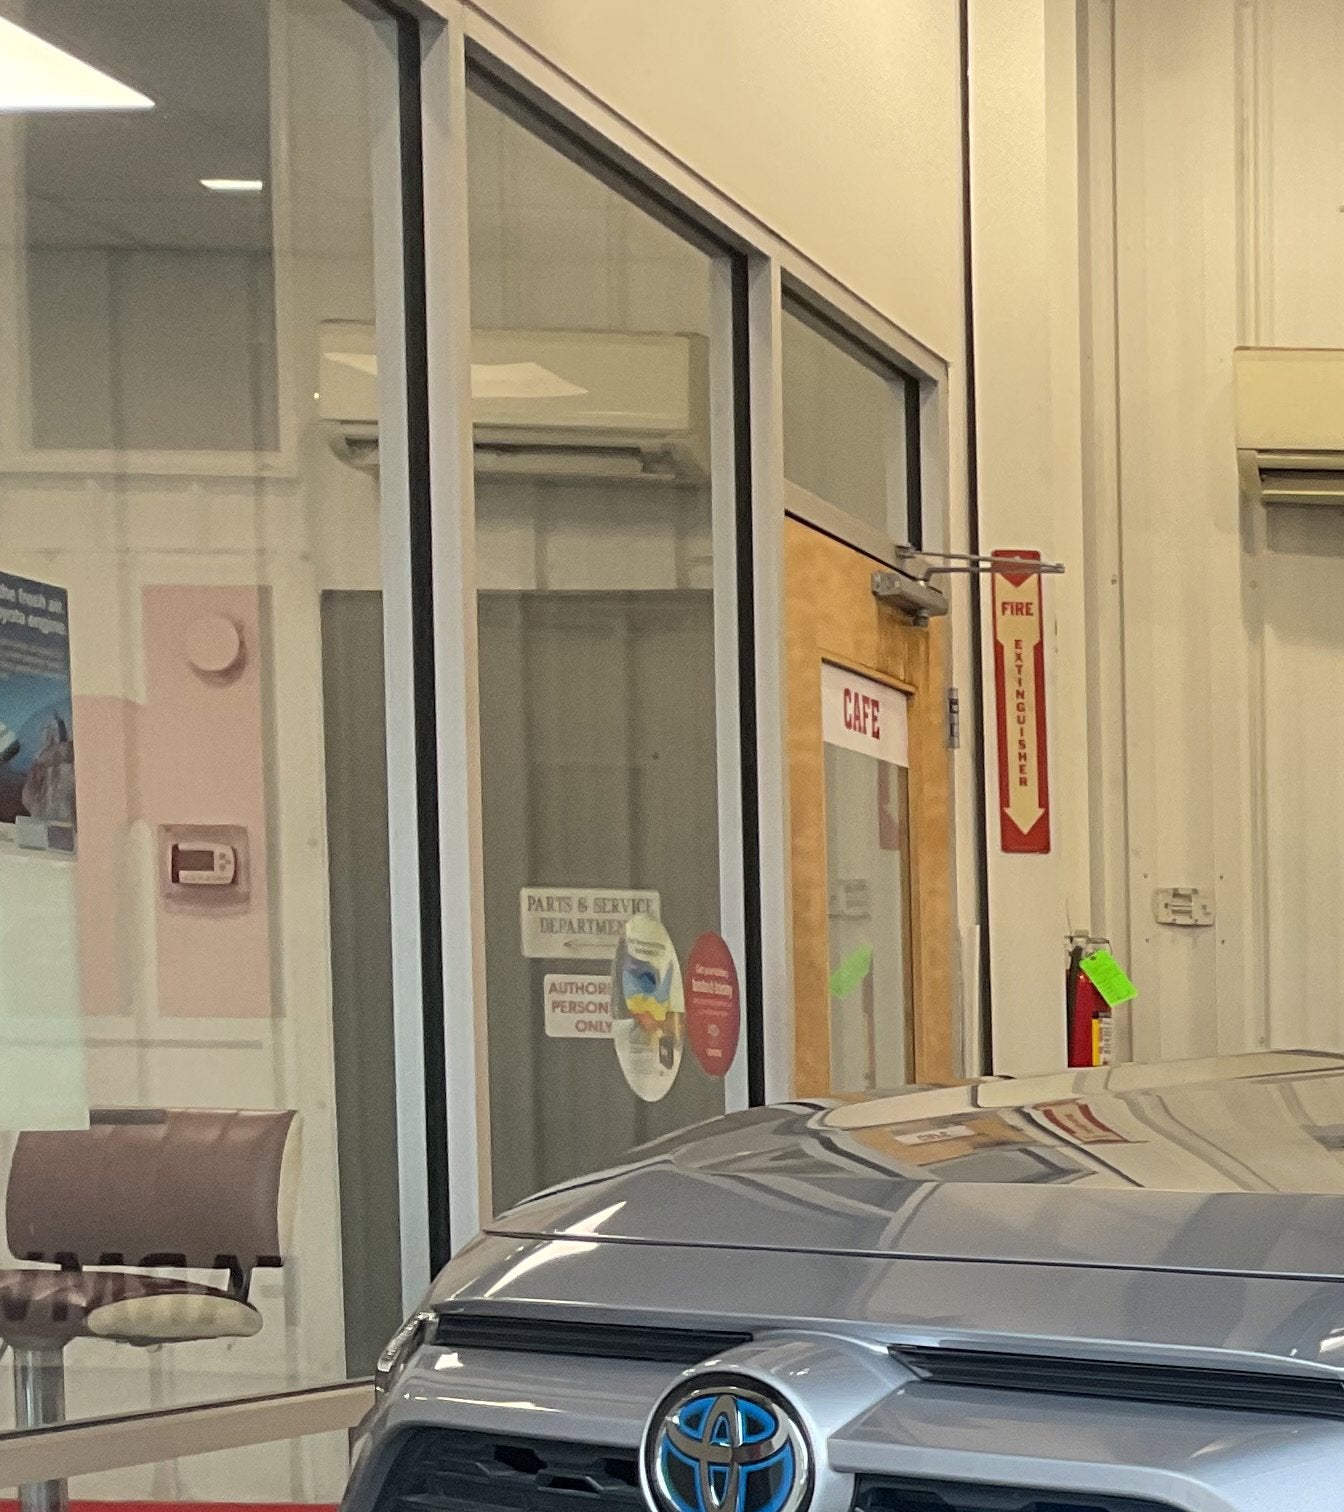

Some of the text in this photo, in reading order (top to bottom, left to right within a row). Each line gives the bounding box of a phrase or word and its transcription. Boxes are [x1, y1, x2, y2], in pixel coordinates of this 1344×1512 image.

[1001, 602, 1034, 617] FIRE
[843, 687, 880, 740] CAFE
[1013, 639, 1028, 787] EXTINGUISHER
[527, 895, 654, 914] PARTS & SERVICE
[540, 917, 626, 936] DEPARTMEN
